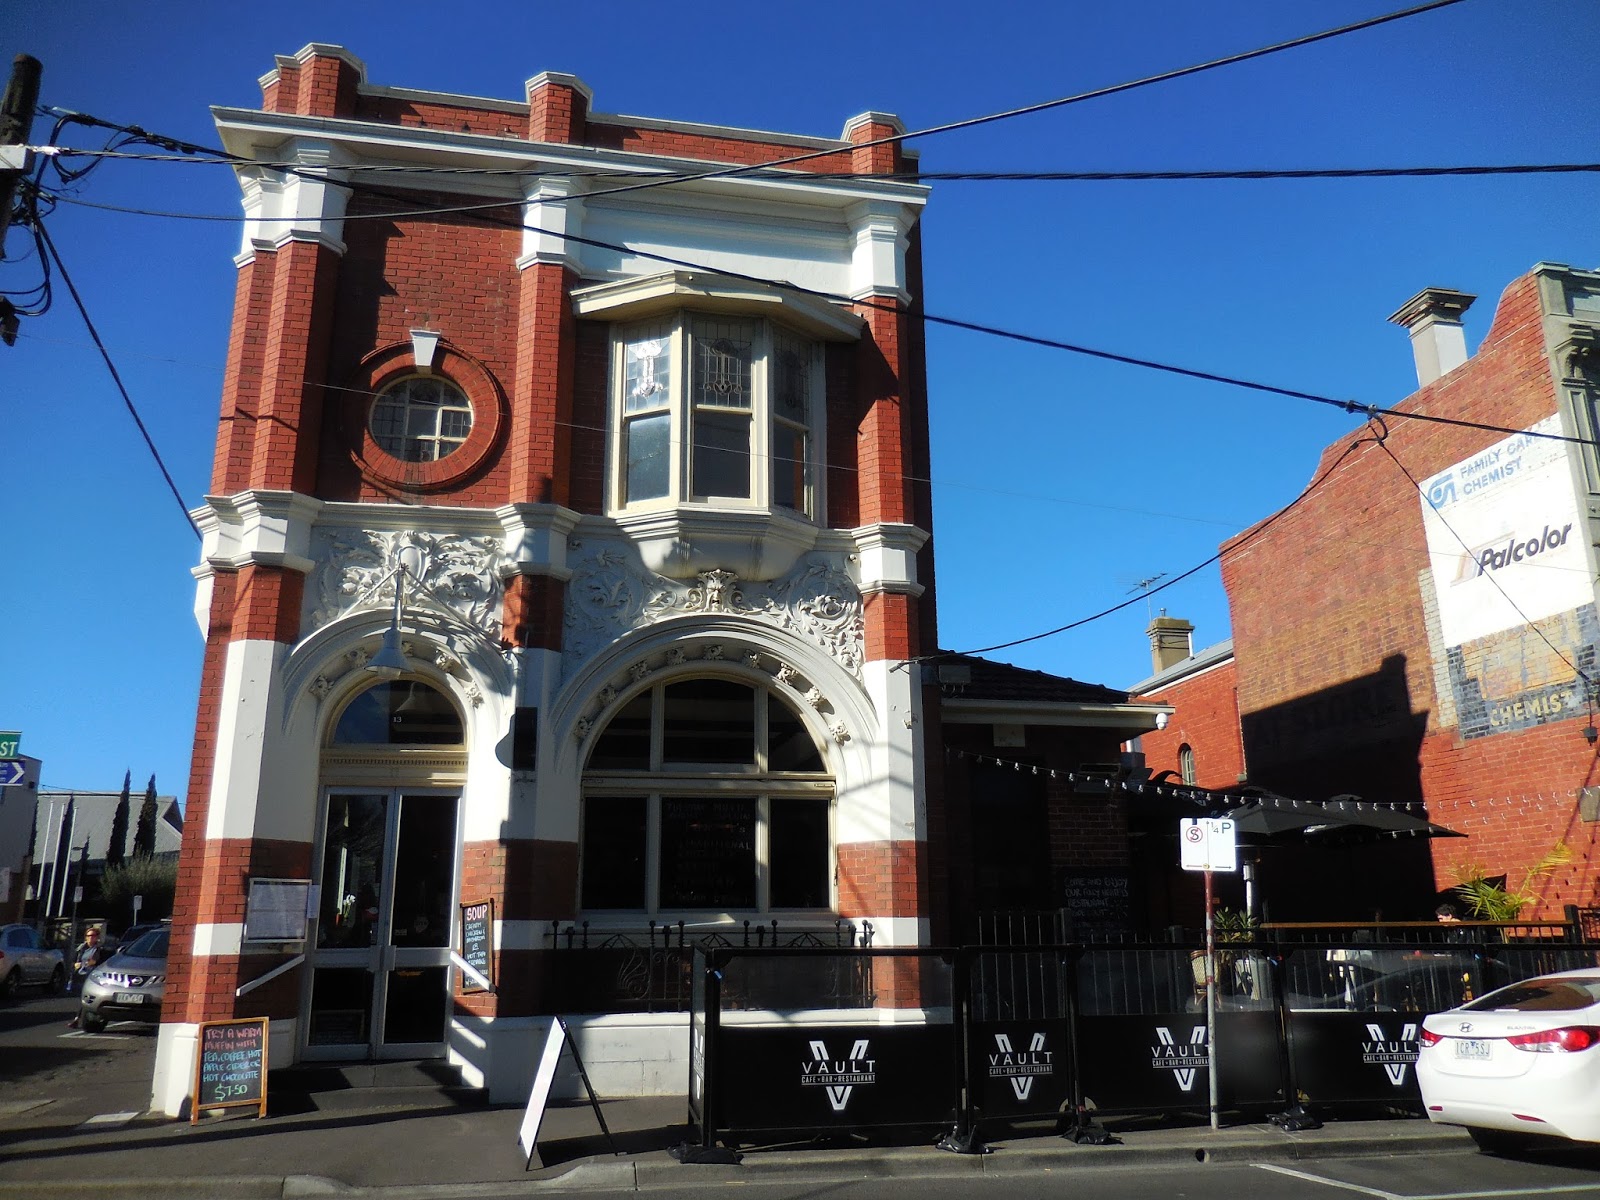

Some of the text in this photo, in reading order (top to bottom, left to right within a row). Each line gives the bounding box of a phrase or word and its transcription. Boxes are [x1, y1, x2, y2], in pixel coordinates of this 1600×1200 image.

[1460, 448, 1502, 478] FAMILY
[1463, 456, 1523, 495] CHEMIST
[1477, 523, 1572, 577] Palcolor
[0, 741, 18, 757] ST
[466, 904, 488, 921] SOUP
[206, 1027, 262, 1040] TRY A WARM
[205, 1039, 257, 1051] MUFFIN WITH
[989, 1051, 1053, 1066] VAULT
[802, 1060, 876, 1074] VAULT
[990, 1067, 1002, 1075] CAFE
[203, 1073, 220, 1083] HOT
[801, 1074, 876, 1084] CAFE BAR RESTAURANT
